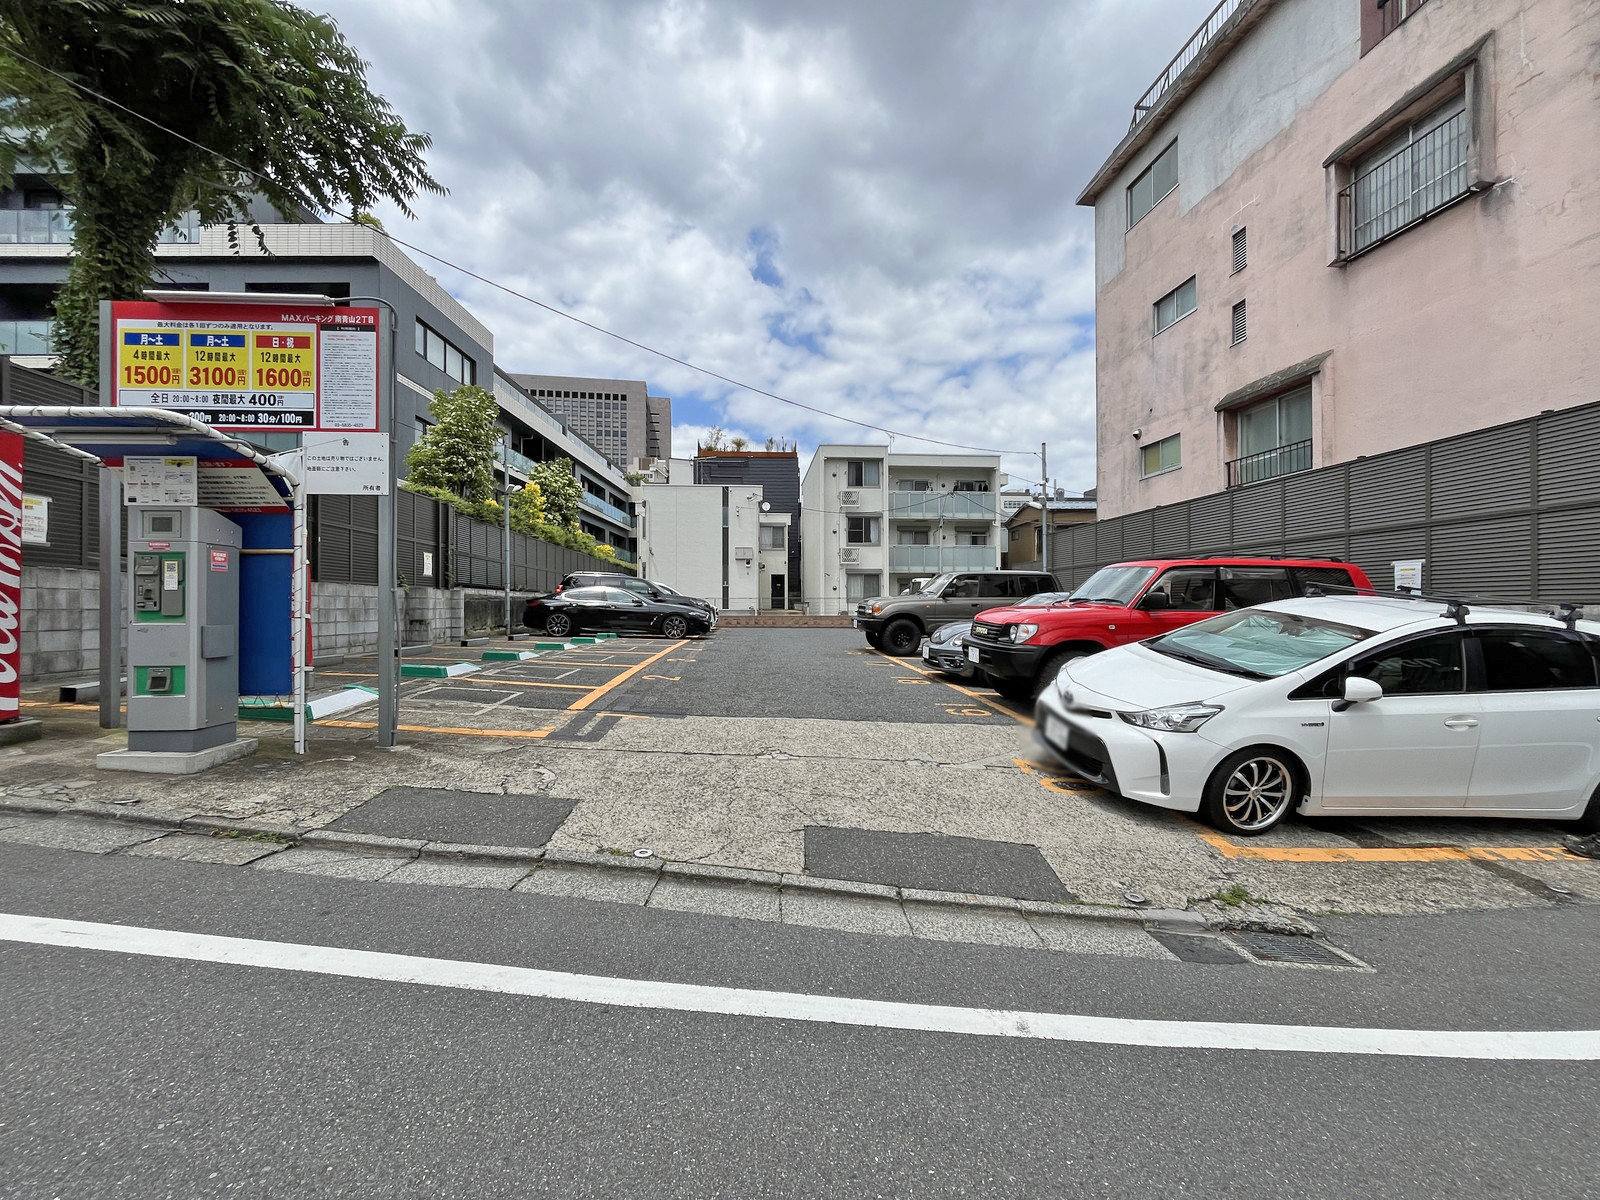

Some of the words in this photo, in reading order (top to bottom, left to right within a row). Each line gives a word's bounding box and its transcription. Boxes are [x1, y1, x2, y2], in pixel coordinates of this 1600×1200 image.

[151, 393, 169, 404] 全日
[212, 394, 246, 405] 夜間最大
[249, 394, 284, 406] 400円
